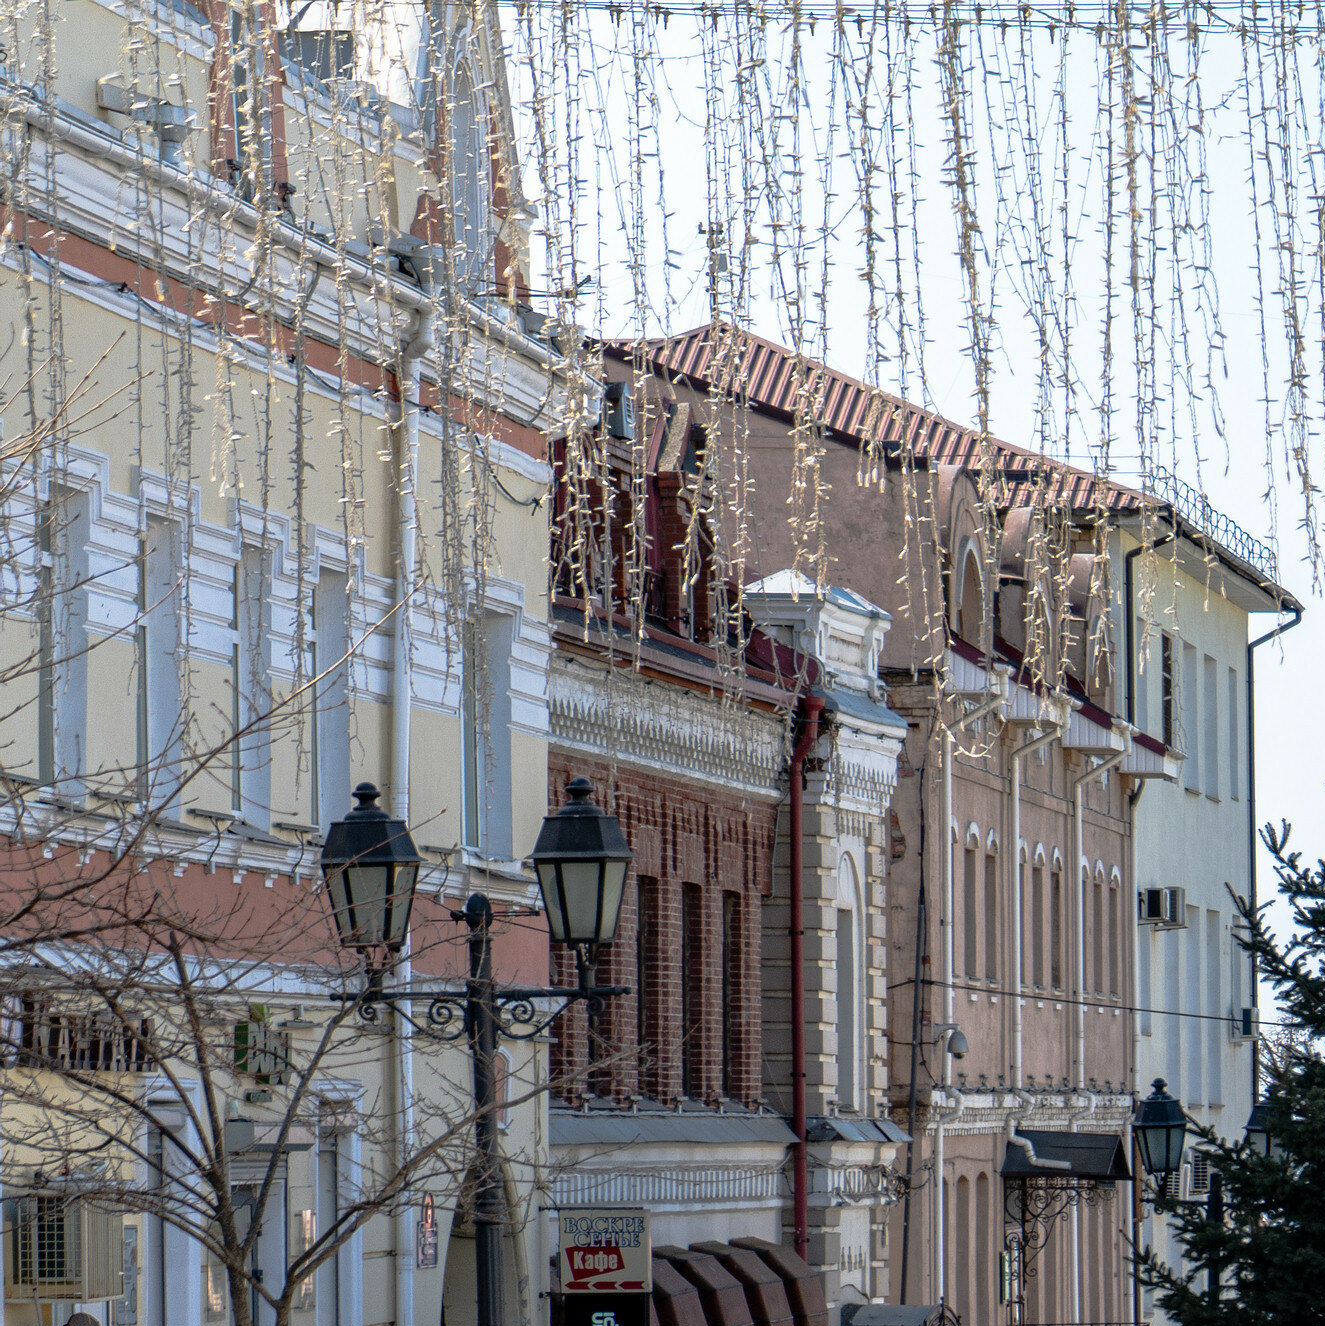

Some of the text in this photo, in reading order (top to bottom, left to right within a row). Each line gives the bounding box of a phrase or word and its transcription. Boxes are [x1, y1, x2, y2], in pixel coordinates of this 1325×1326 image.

[564, 1216, 645, 1234] ВОСКРЕ
[574, 1232, 641, 1248] СЕНЬЕ
[573, 1250, 618, 1272] Кафе
